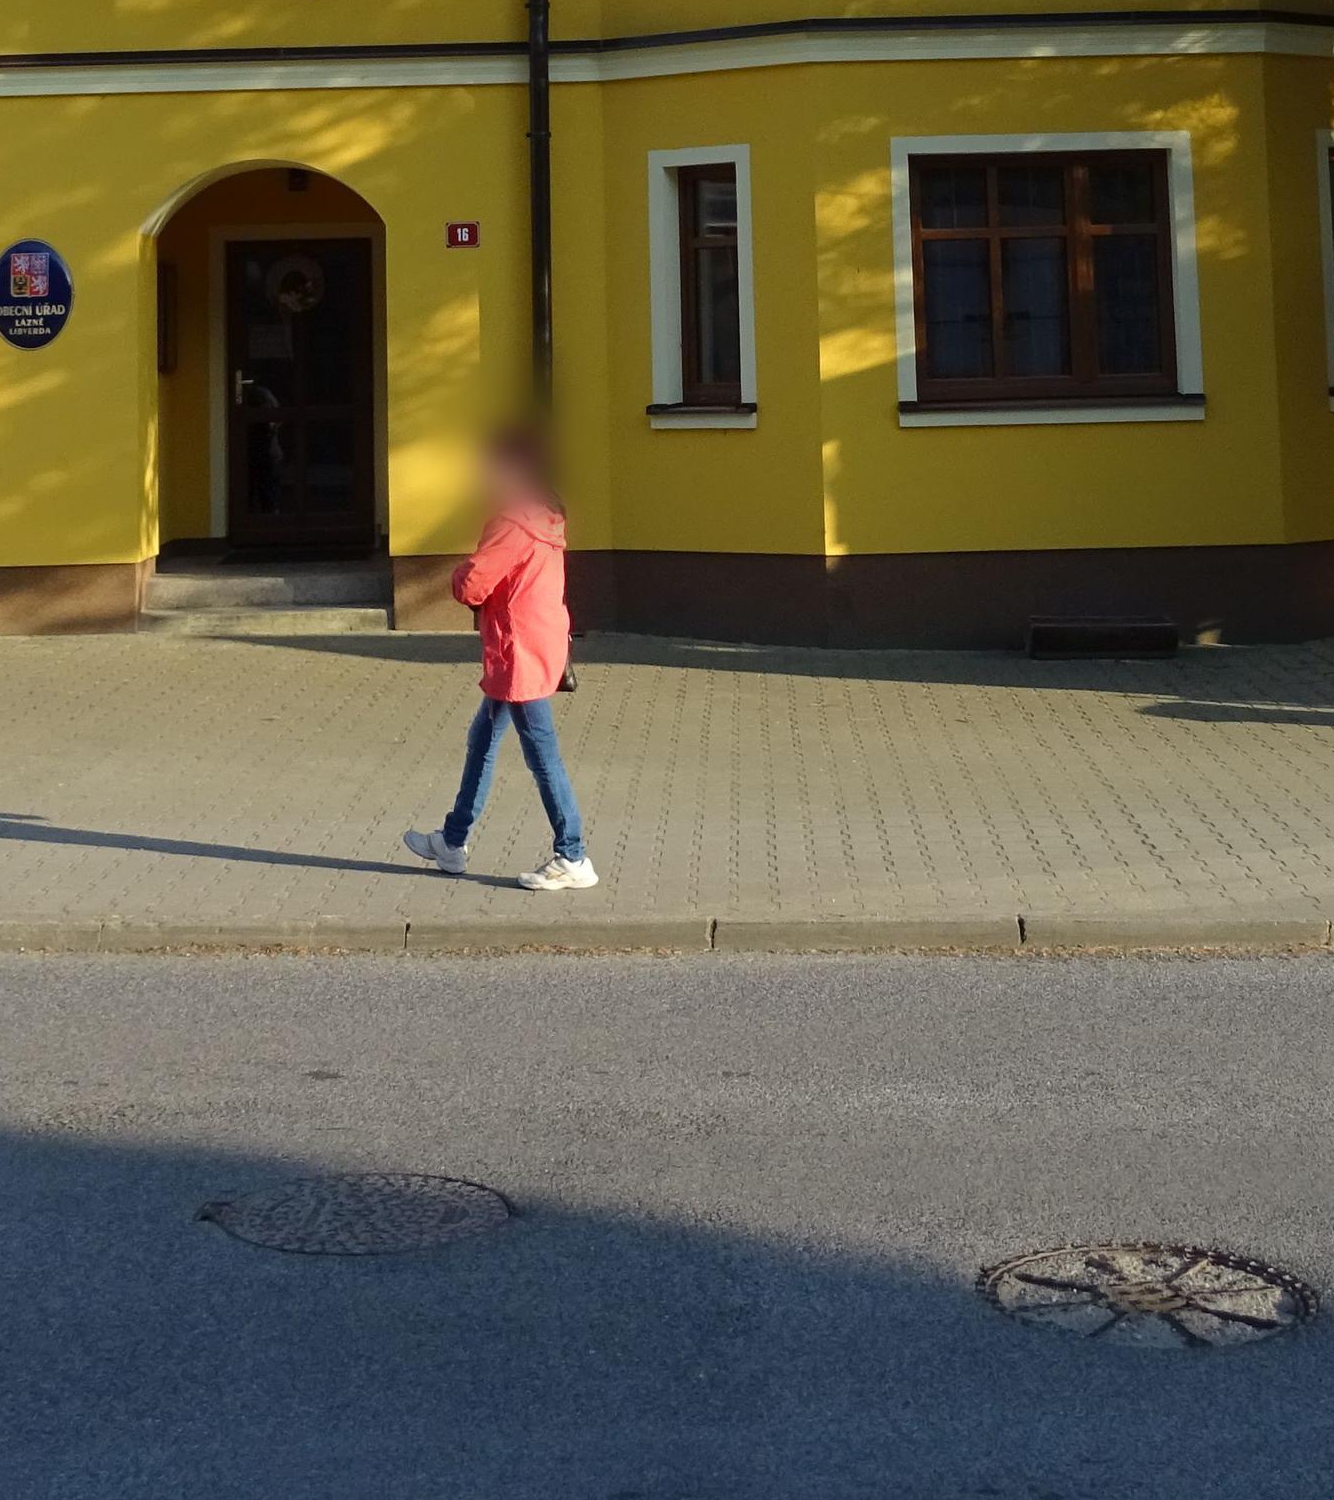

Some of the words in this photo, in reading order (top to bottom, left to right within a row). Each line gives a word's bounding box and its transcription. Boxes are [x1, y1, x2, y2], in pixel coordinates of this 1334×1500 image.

[457, 227, 469, 242] 16
[35, 302, 66, 316] ÚŘAD
[9, 327, 51, 336] LIBVERDA
